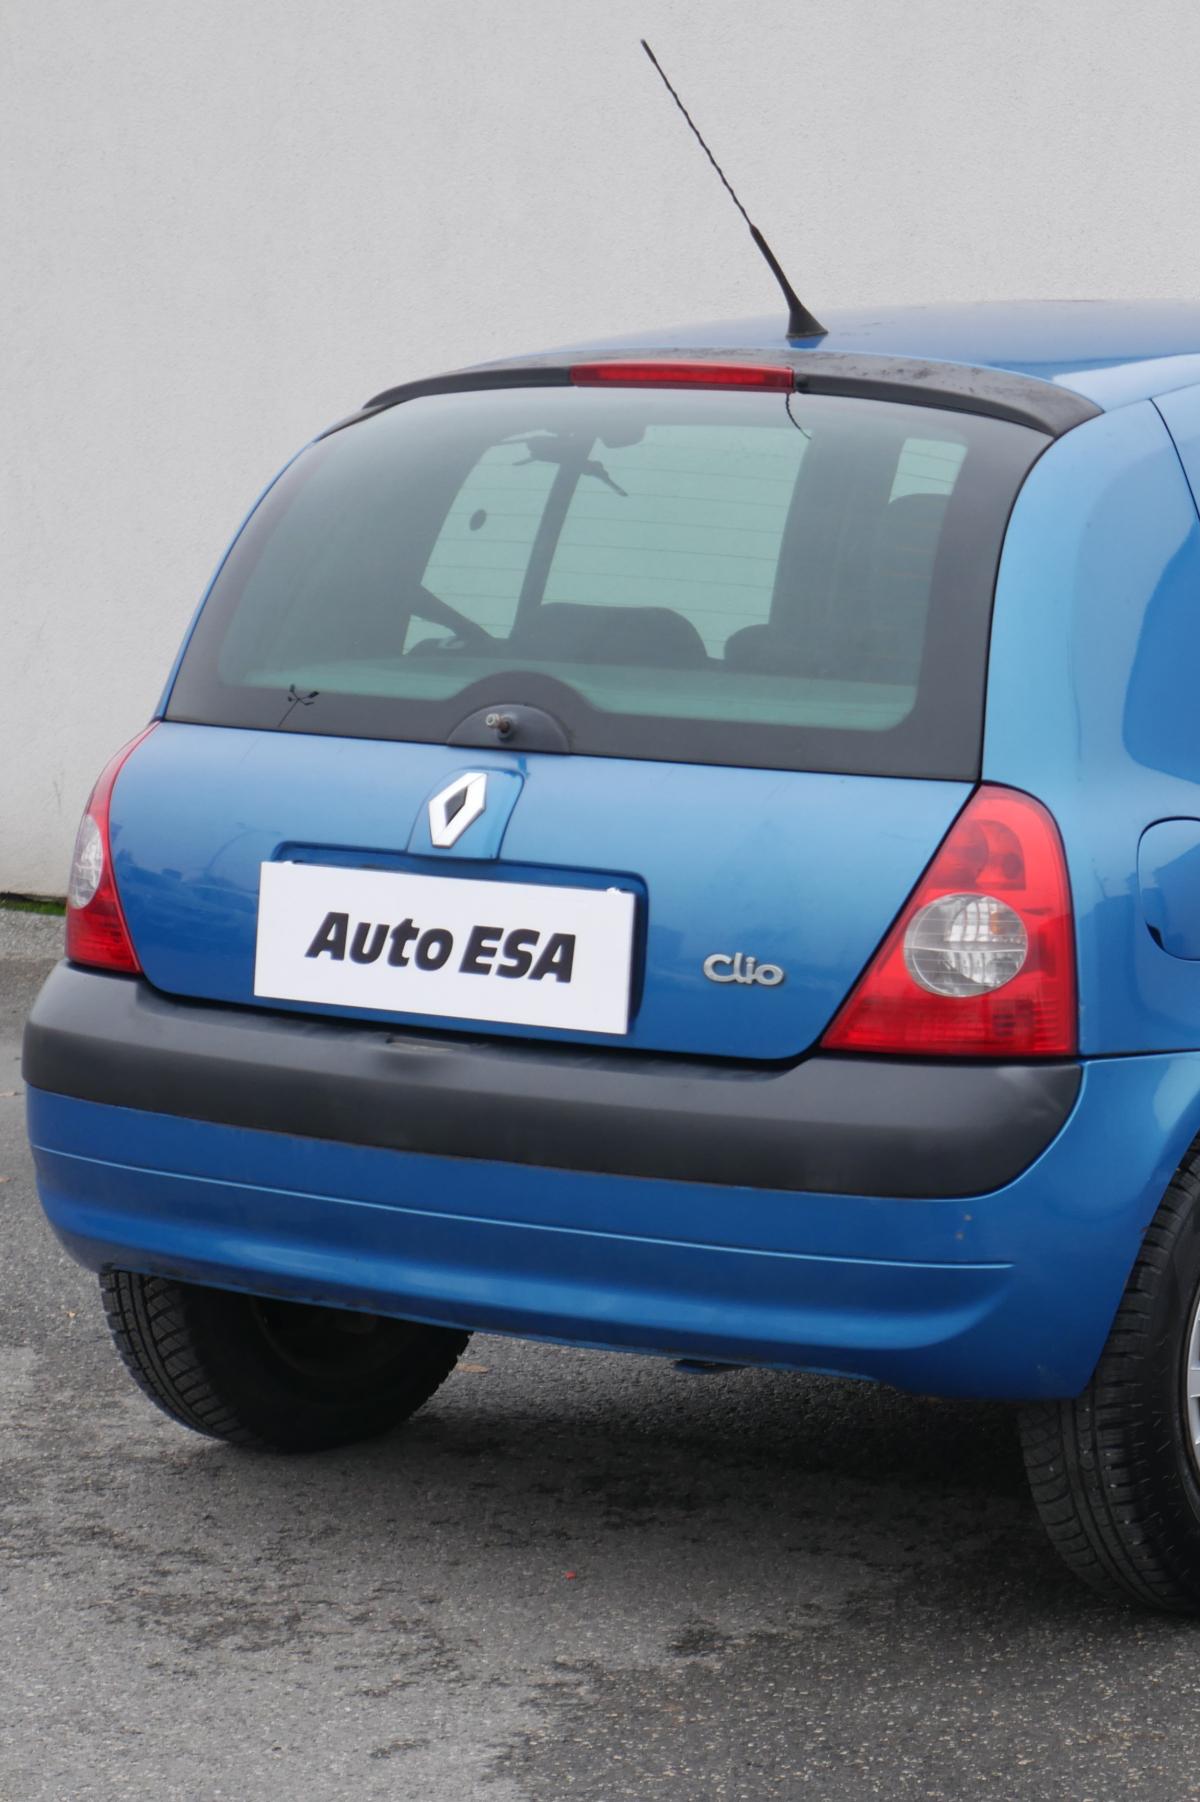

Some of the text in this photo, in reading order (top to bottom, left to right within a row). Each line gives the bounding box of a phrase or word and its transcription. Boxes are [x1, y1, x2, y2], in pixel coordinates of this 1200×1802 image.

[304, 911, 577, 984] Auto ESA
[703, 952, 784, 985] Clio
